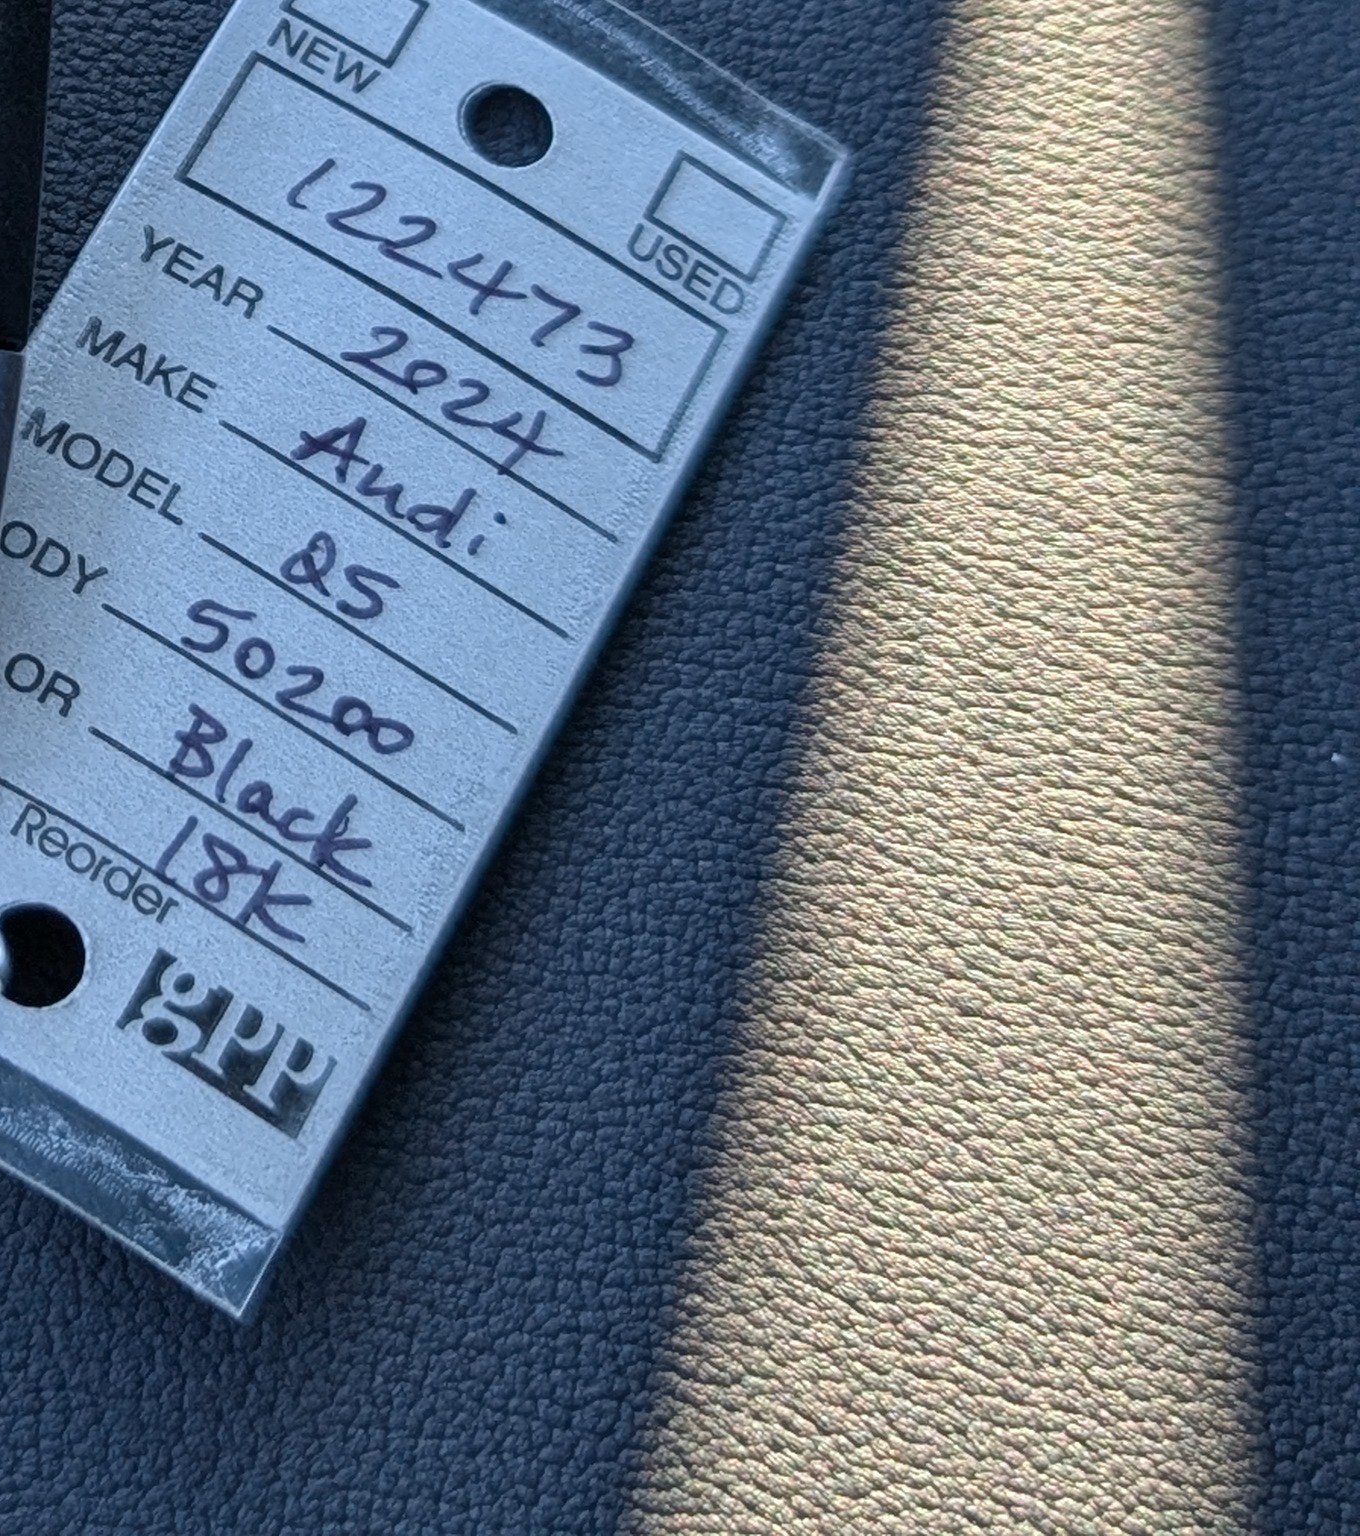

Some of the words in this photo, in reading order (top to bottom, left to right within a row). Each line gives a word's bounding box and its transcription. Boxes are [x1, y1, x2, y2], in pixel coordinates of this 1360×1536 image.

[268, 16, 382, 96] NEW
[138, 225, 266, 320] YEAR
[286, 158, 636, 388] 122473
[627, 223, 749, 319] USED
[77, 317, 218, 413] MAKE
[340, 326, 566, 476] 2024
[21, 406, 183, 526] MODEL
[0, 520, 108, 595] ODY
[180, 597, 416, 756] 50200
[166, 704, 373, 889] Black
[10, 802, 180, 925] Reorder
